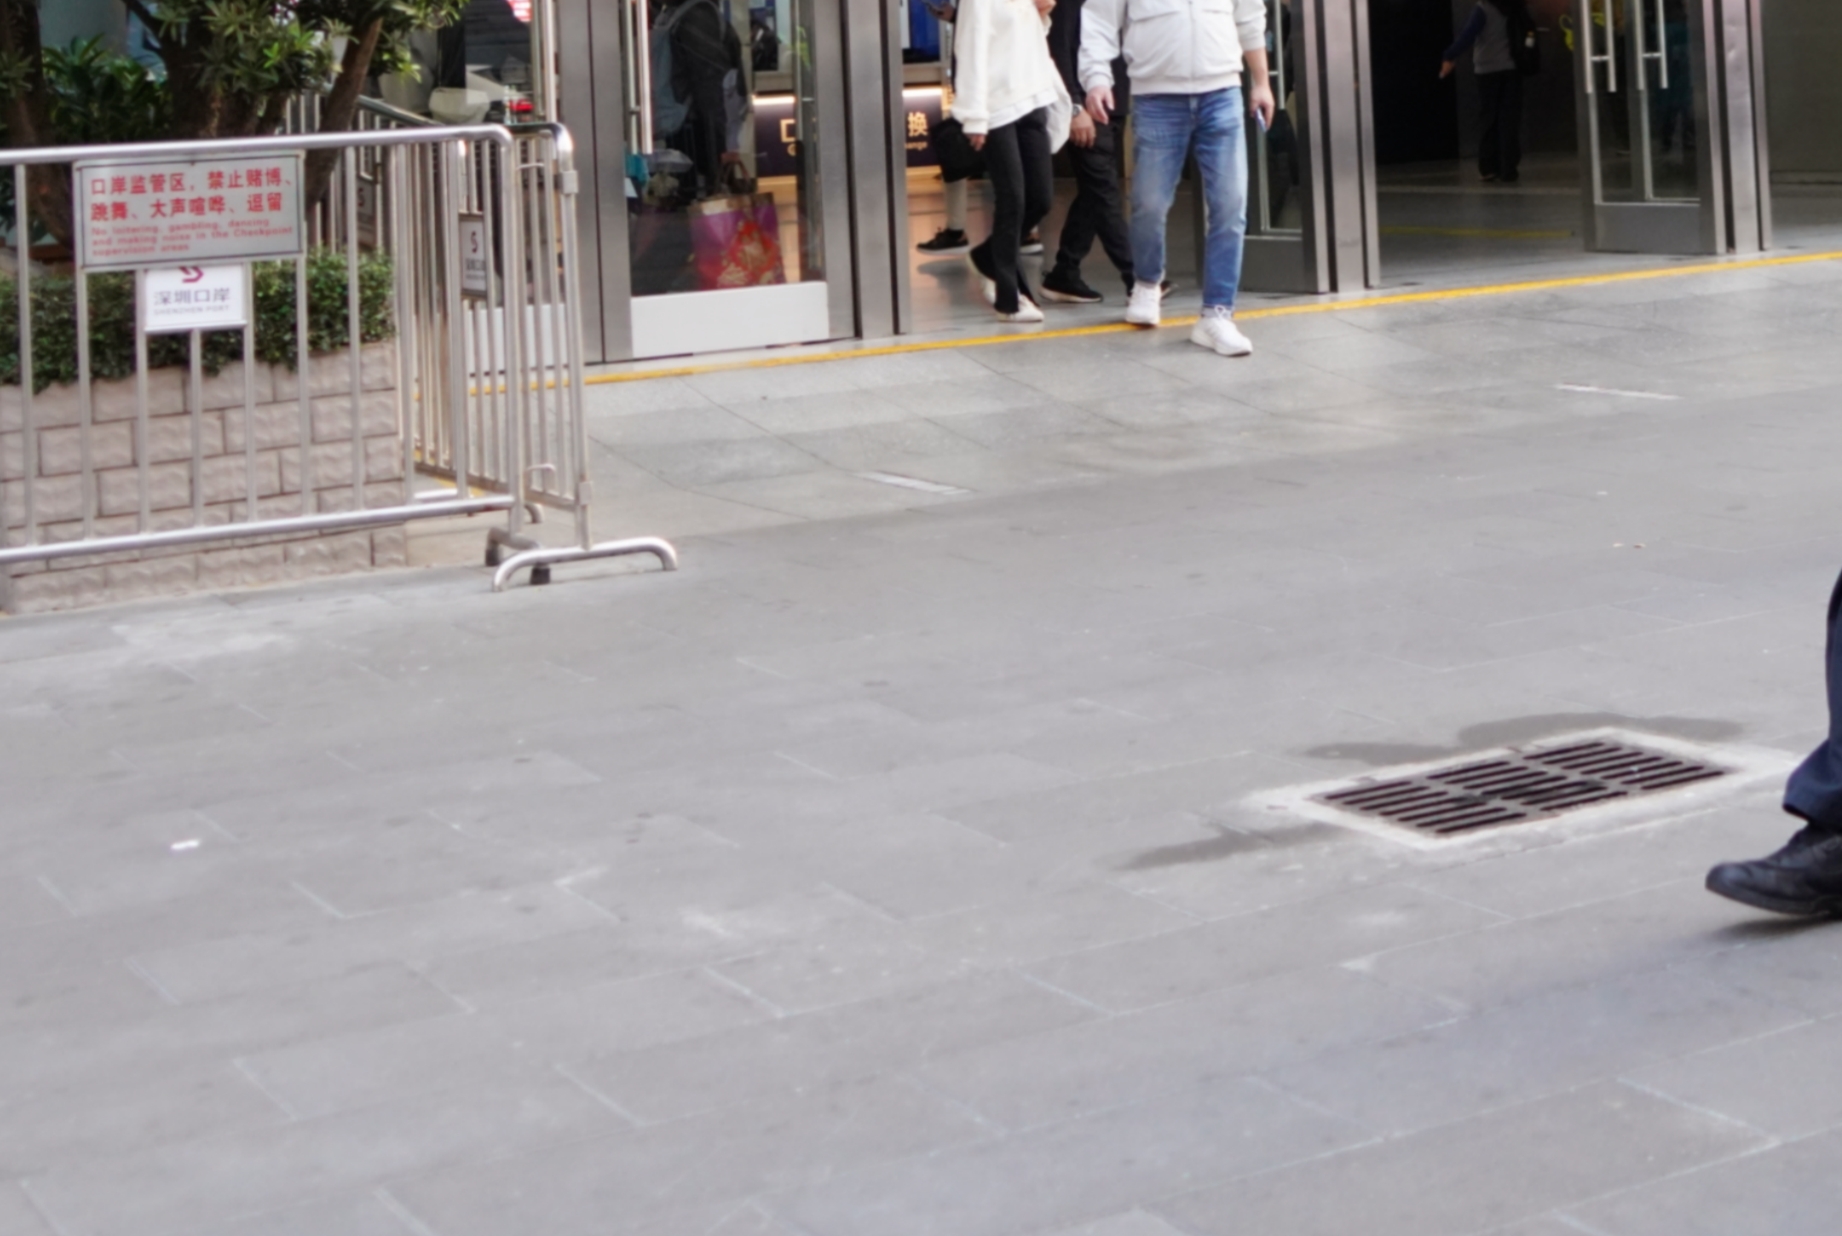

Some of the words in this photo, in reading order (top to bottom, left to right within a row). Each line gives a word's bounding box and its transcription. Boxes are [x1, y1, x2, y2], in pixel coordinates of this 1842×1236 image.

[228, 218, 270, 229] dancing
[92, 237, 112, 246] and
[117, 234, 158, 246] making
[162, 233, 191, 241] noise
[196, 232, 206, 240] in
[211, 230, 229, 239] the
[233, 226, 293, 238] Checkpoint
[92, 246, 156, 258] supervision
[160, 243, 190, 252] areas
[153, 288, 231, 306] 深圳口岸
